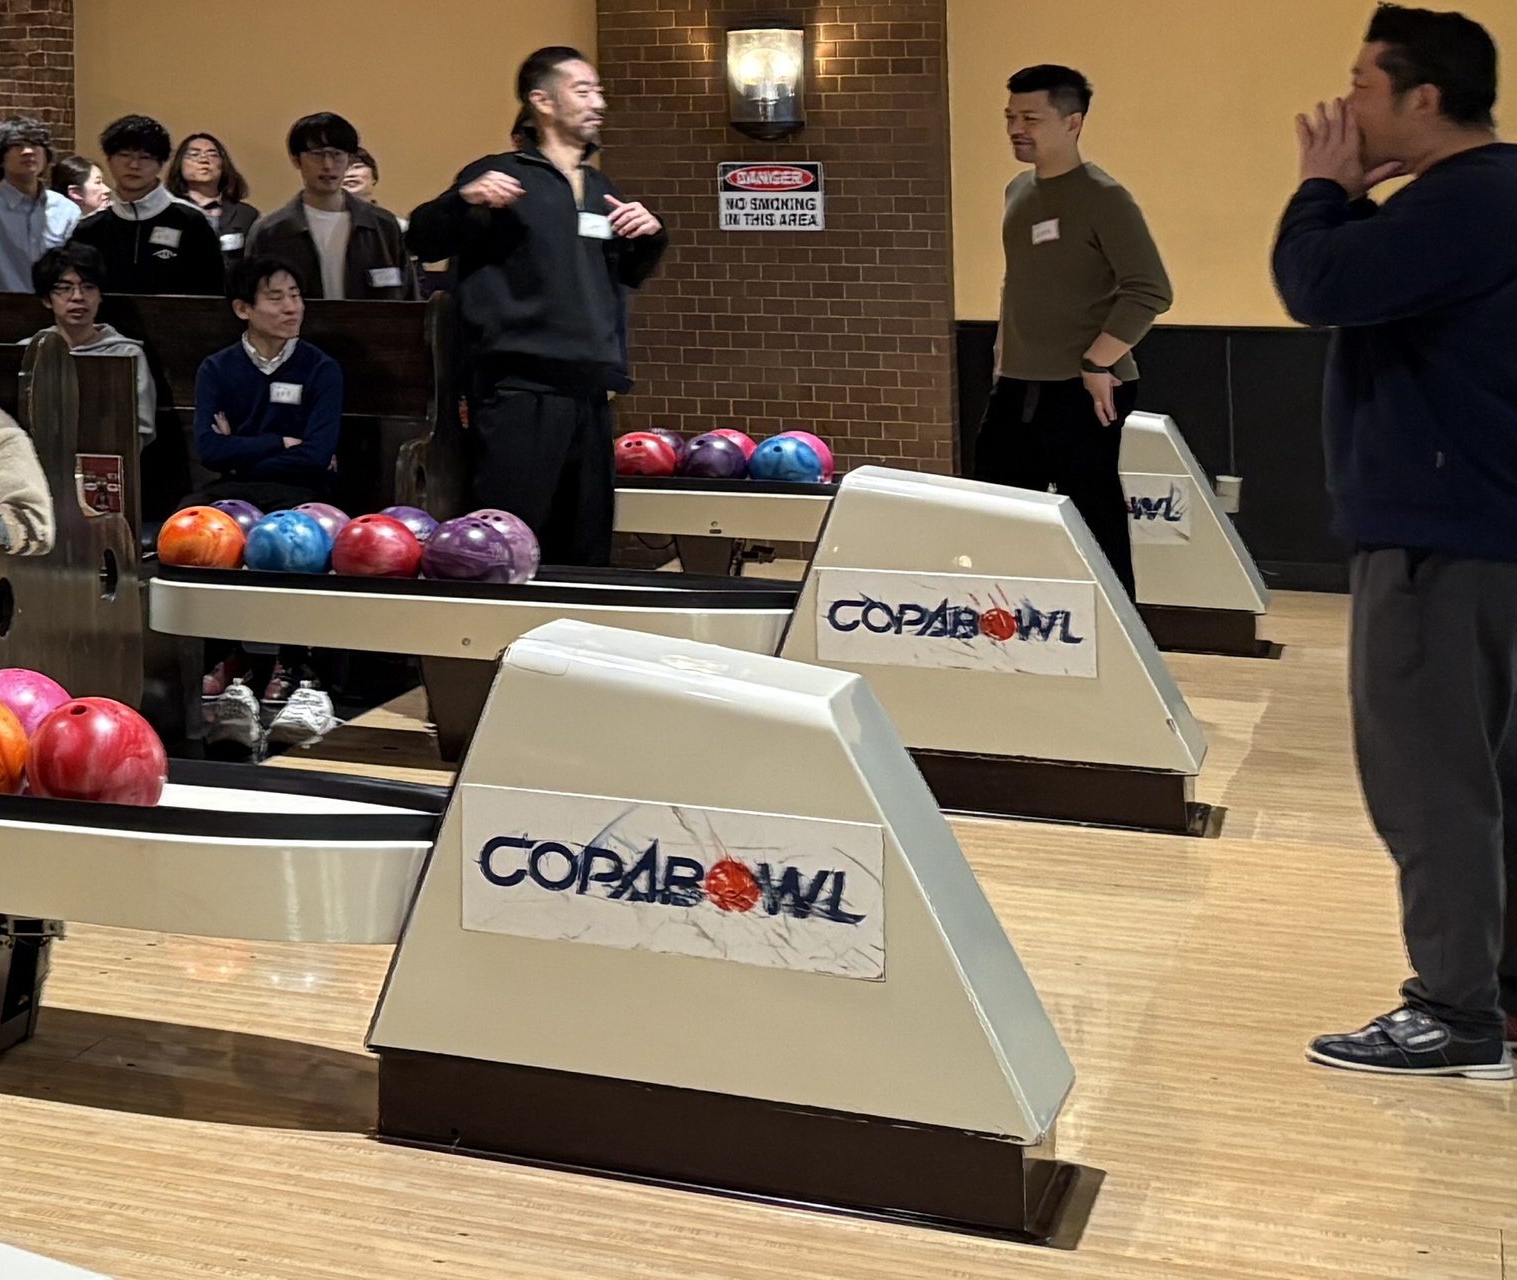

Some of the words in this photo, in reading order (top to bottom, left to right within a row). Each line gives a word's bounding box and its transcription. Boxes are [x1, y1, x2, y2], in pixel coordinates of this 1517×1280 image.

[736, 170, 803, 185] DANGER
[726, 198, 746, 210] NO
[750, 198, 817, 210] SMOKING
[725, 213, 740, 226] IN
[743, 213, 775, 226] THIS
[779, 213, 818, 226] AREA
[826, 598, 1084, 644] COPABOWL
[479, 834, 867, 925] COPABOWL
